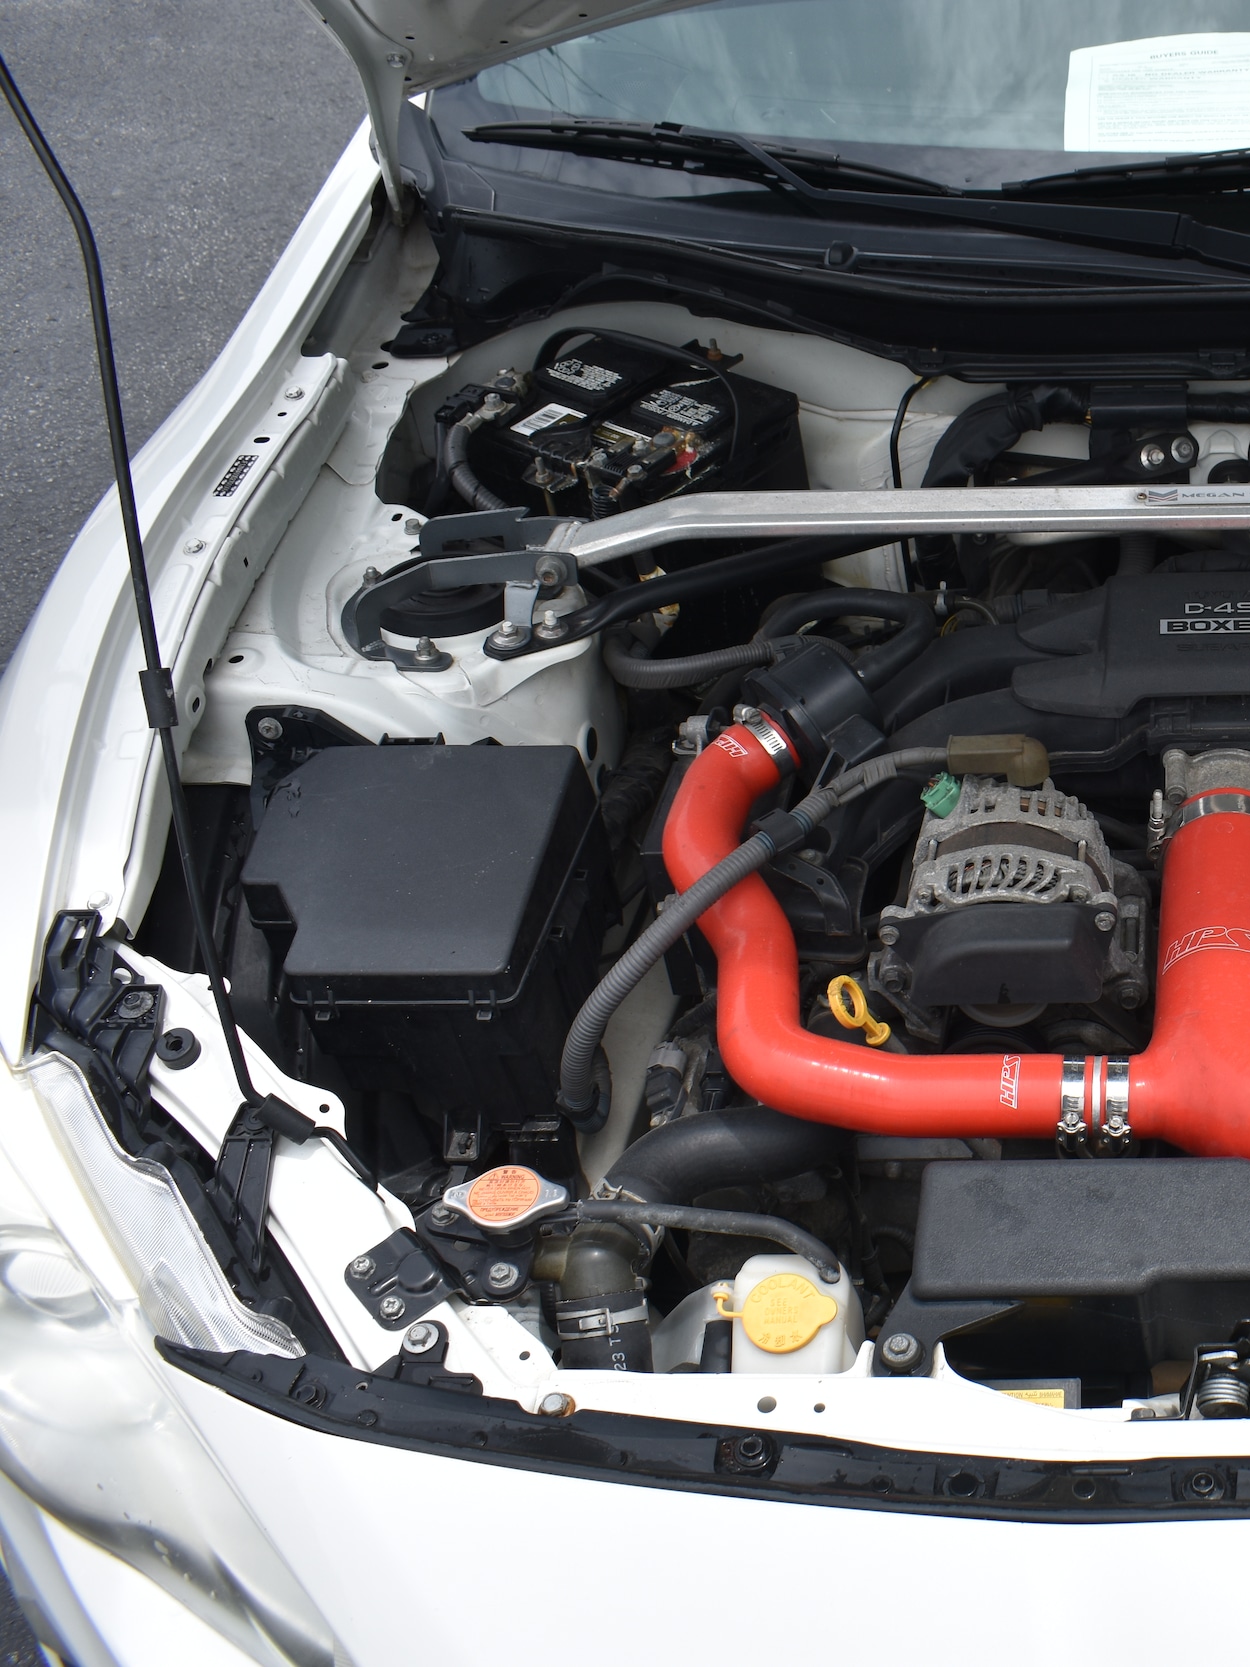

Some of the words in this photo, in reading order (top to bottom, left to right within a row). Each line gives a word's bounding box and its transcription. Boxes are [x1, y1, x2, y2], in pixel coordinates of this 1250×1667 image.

[1150, 50, 1187, 60] BUYERS
[1000, 1055, 1021, 1110] HPS
[750, 1277, 816, 1303] COOLANT
[770, 1297, 788, 1307] SEE
[764, 1306, 798, 1316] OWNERS
[764, 1315, 798, 1325] MANUAL
